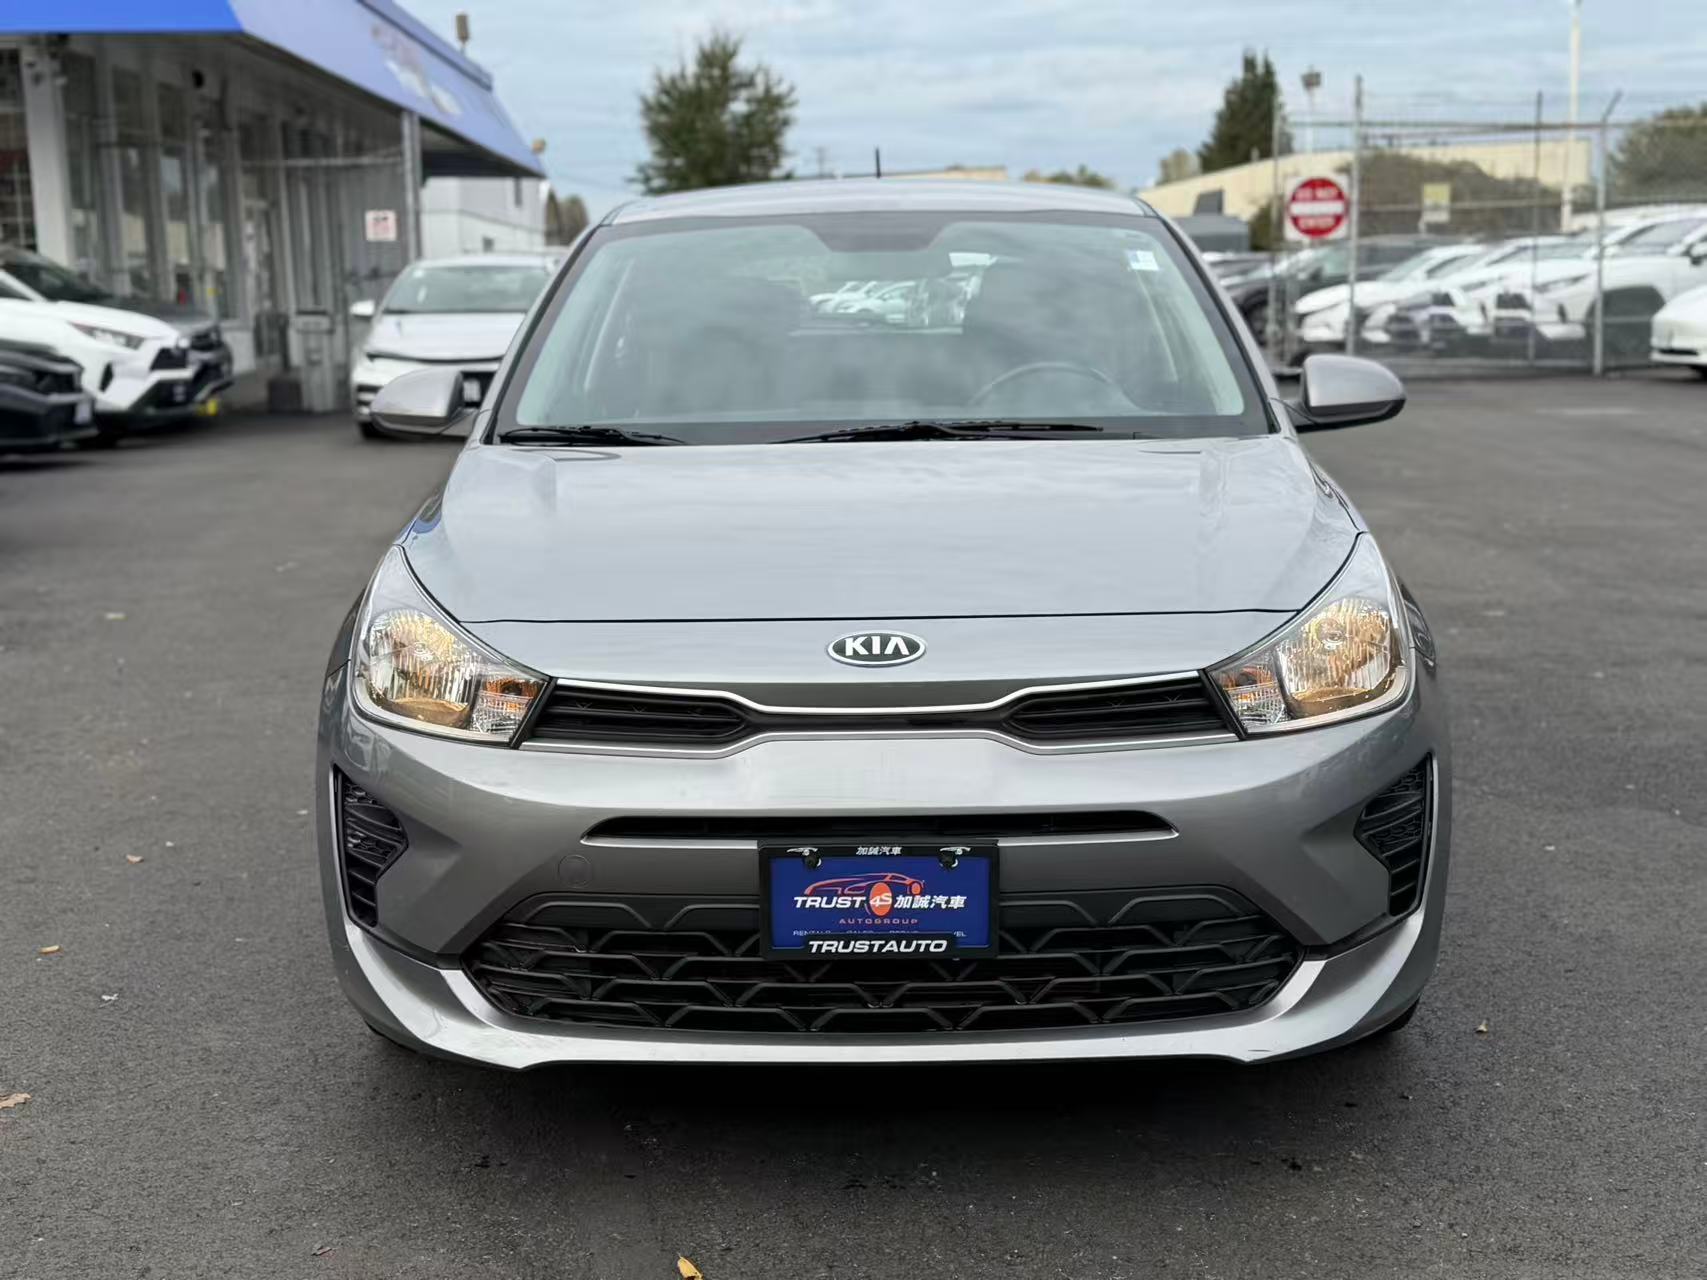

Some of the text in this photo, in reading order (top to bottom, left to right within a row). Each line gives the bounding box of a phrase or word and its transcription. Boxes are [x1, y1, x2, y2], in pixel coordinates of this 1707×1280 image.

[844, 635, 910, 656] KIA
[856, 846, 902, 856] 加誠汽車
[793, 893, 967, 909] TRUST 4S 加誠汽車
[838, 917, 919, 925] AUTOGROUP
[808, 939, 948, 954] TRUSTAUTO
